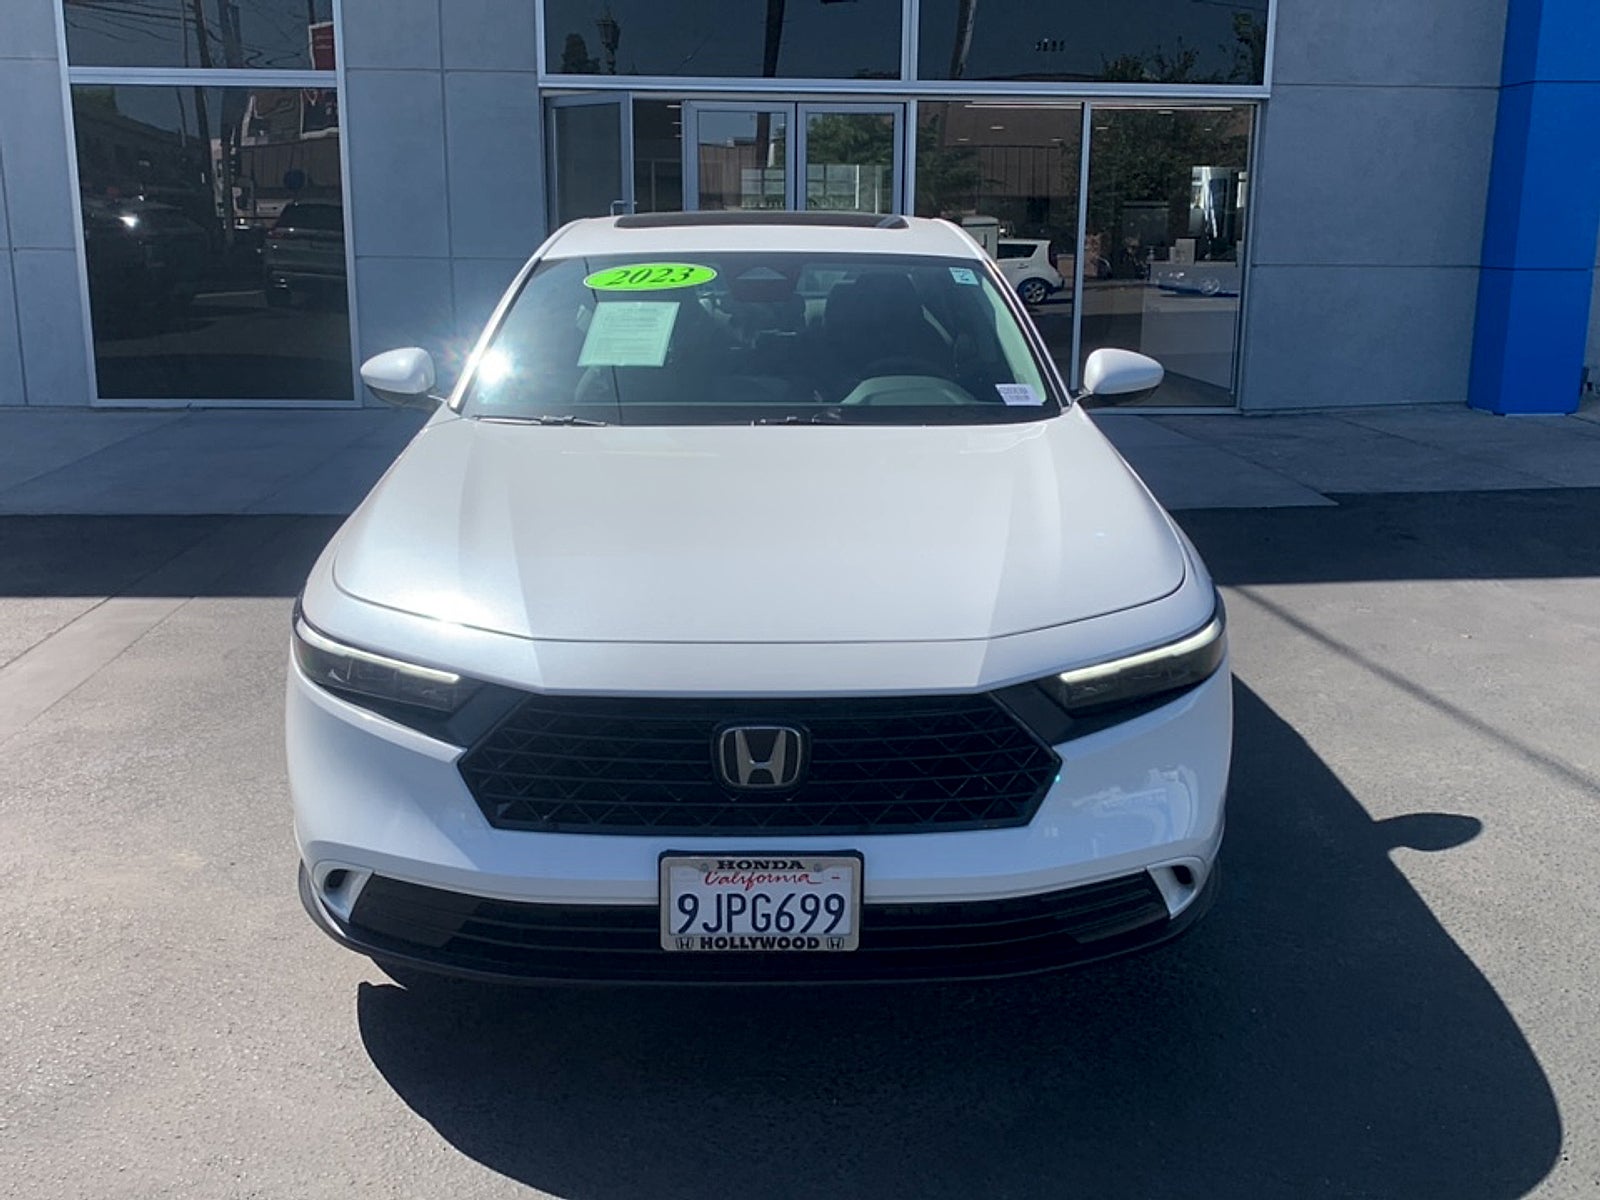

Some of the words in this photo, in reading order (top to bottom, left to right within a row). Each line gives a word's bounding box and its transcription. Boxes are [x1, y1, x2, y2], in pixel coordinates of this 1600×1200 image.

[605, 267, 695, 286] 2023
[717, 860, 805, 869] HONDA
[704, 871, 823, 891] California
[677, 893, 845, 934] 9JPG699
[700, 937, 820, 949] HOLLYWOOD
